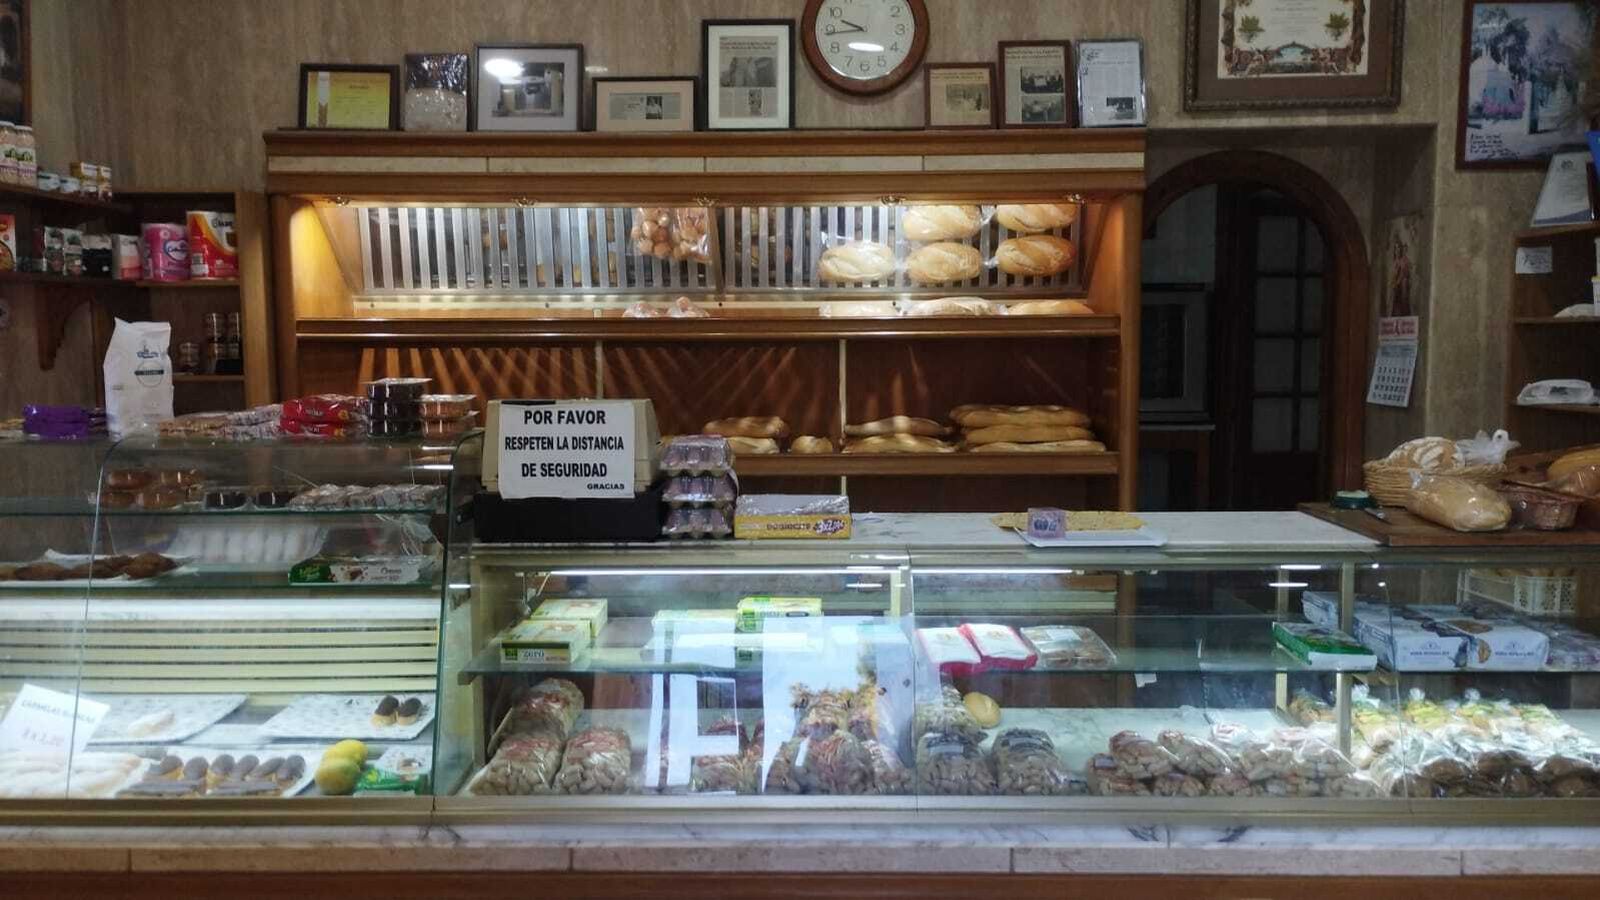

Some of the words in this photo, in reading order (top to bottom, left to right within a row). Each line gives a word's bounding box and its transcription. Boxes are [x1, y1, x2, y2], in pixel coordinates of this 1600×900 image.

[830, 7, 842, 18] 10
[890, 5, 901, 18] 2
[826, 24, 836, 34] 9
[895, 24, 905, 35] 3
[830, 42, 840, 54] 8
[890, 42, 899, 52] 4
[844, 56, 854, 67] 7
[860, 61, 870, 72] 6
[877, 56, 887, 67] 5
[524, 410, 553, 424] POR
[557, 410, 606, 424] FAVOR
[505, 436, 553, 450] RESPETEN
[557, 436, 569, 450] LA
[572, 436, 624, 450] DISTANCIA
[522, 463, 537, 477] DE
[540, 463, 607, 477] SEGURIDAD
